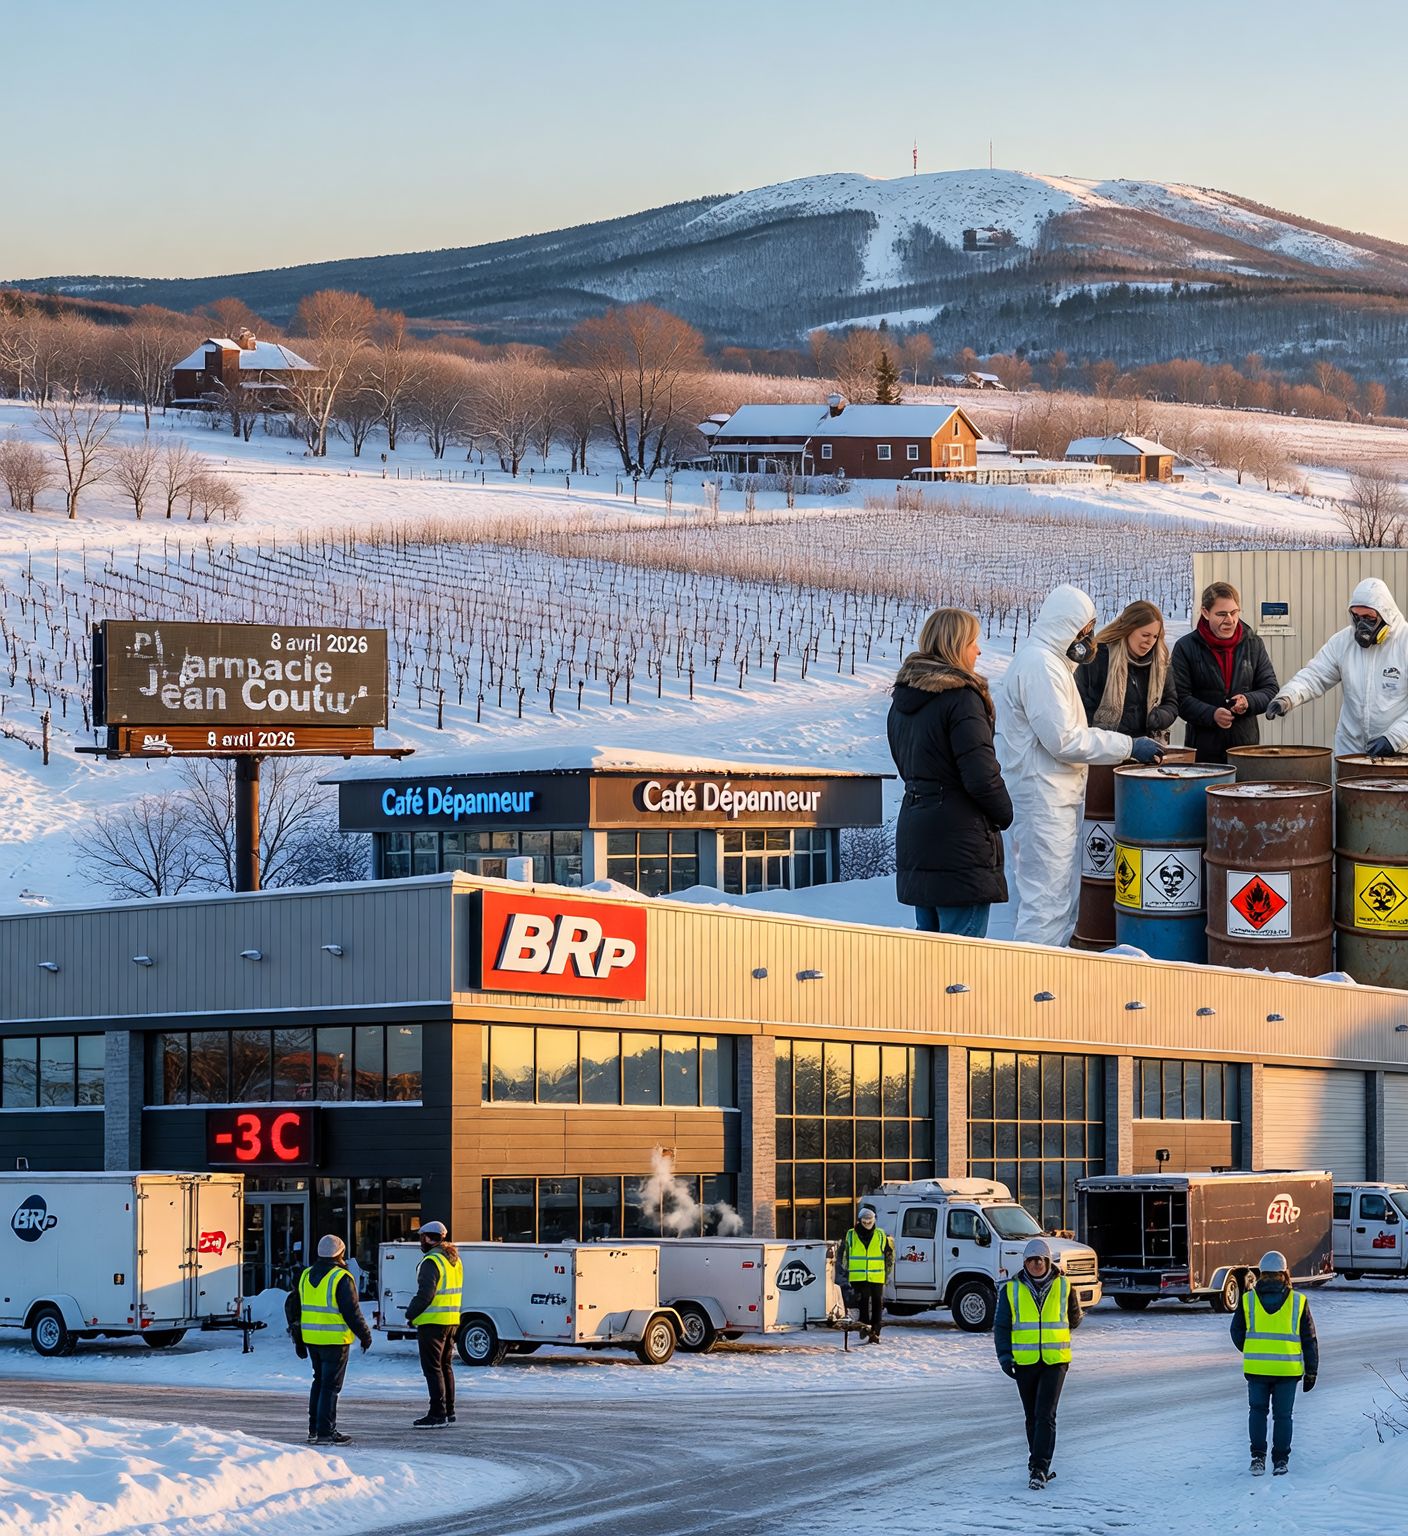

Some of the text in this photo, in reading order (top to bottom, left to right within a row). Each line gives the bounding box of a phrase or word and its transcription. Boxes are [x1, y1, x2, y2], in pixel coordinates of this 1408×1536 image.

[270, 632, 368, 654] 8 avril 2026
[258, 731, 296, 747] 2026
[382, 785, 534, 822] Café Dépanneur
[642, 780, 822, 819] Café Dépanneur
